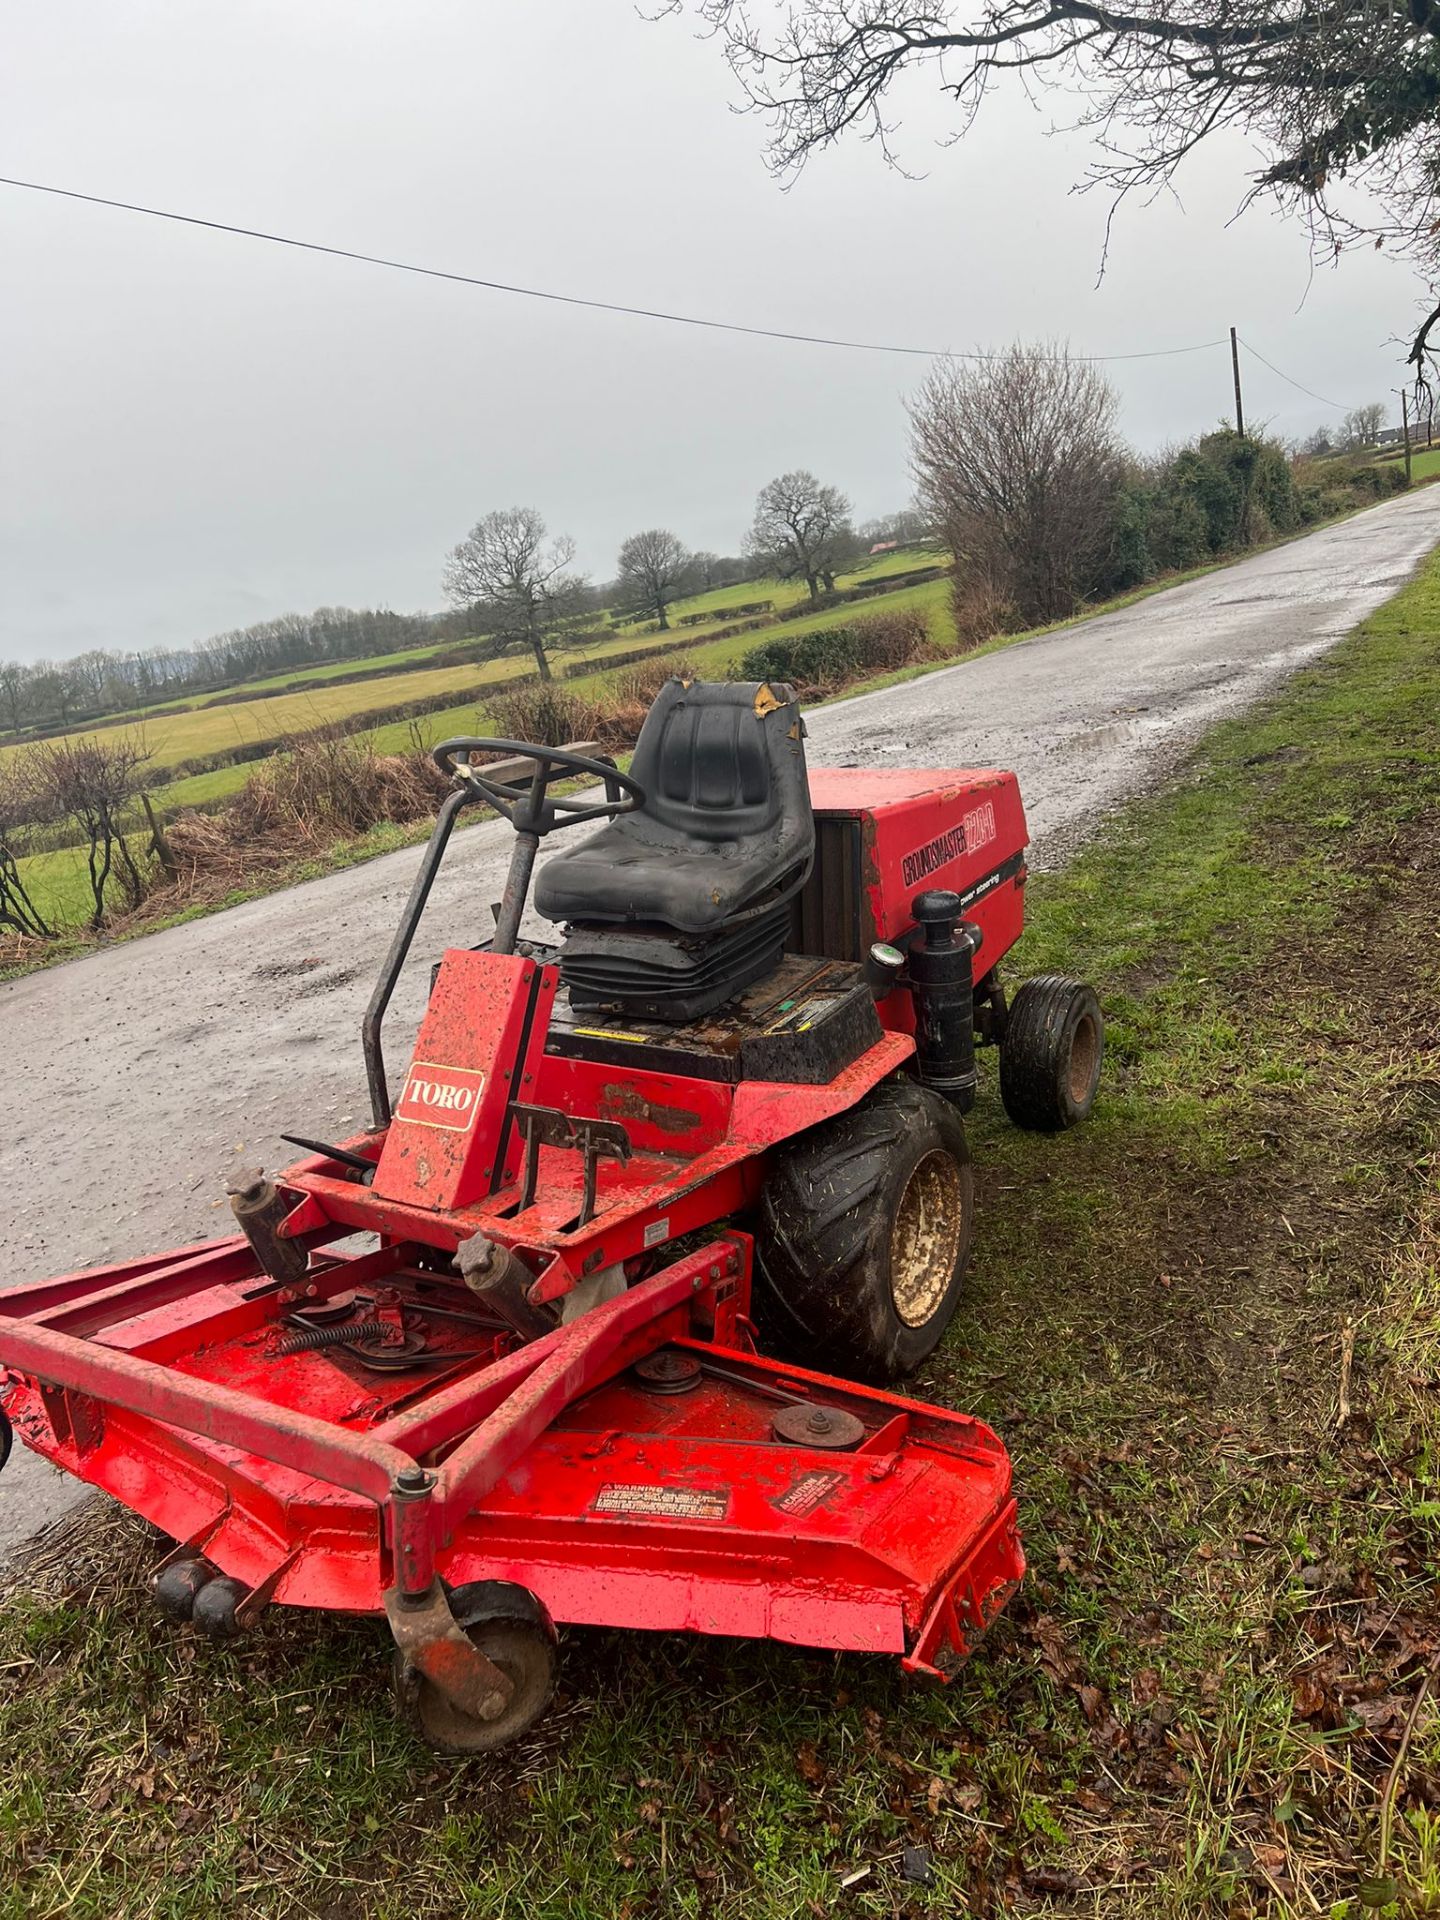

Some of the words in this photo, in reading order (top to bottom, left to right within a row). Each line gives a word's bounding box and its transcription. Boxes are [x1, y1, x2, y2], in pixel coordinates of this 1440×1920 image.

[902, 824, 967, 888] GROUNDSMASTER
[960, 890, 976, 906] ower
[409, 1079, 472, 1111] TORO
[614, 1483, 664, 1493] WARNING
[784, 1477, 818, 1505] CAUTION
